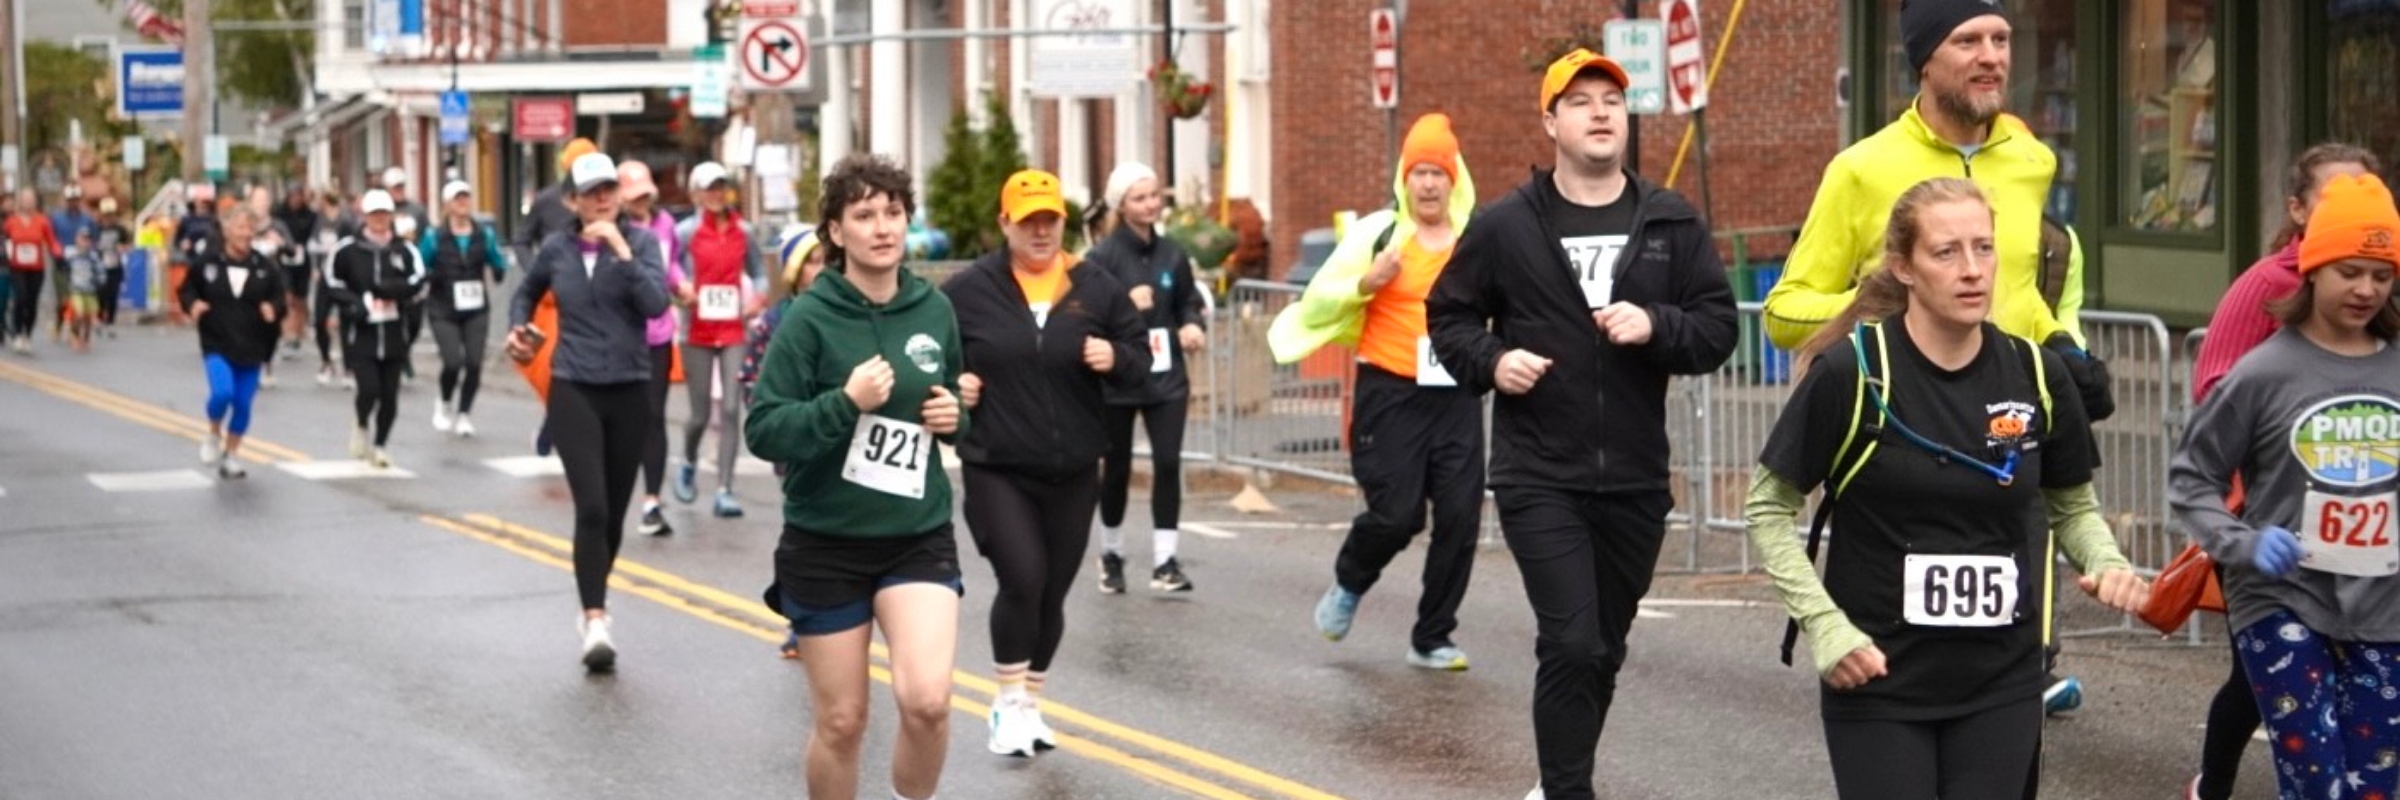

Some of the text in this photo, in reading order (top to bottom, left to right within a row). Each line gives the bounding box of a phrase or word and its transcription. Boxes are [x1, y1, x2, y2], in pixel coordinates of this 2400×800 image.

[865, 423, 920, 471] 921
[2320, 501, 2389, 546] 622
[1924, 564, 2003, 618] 695
